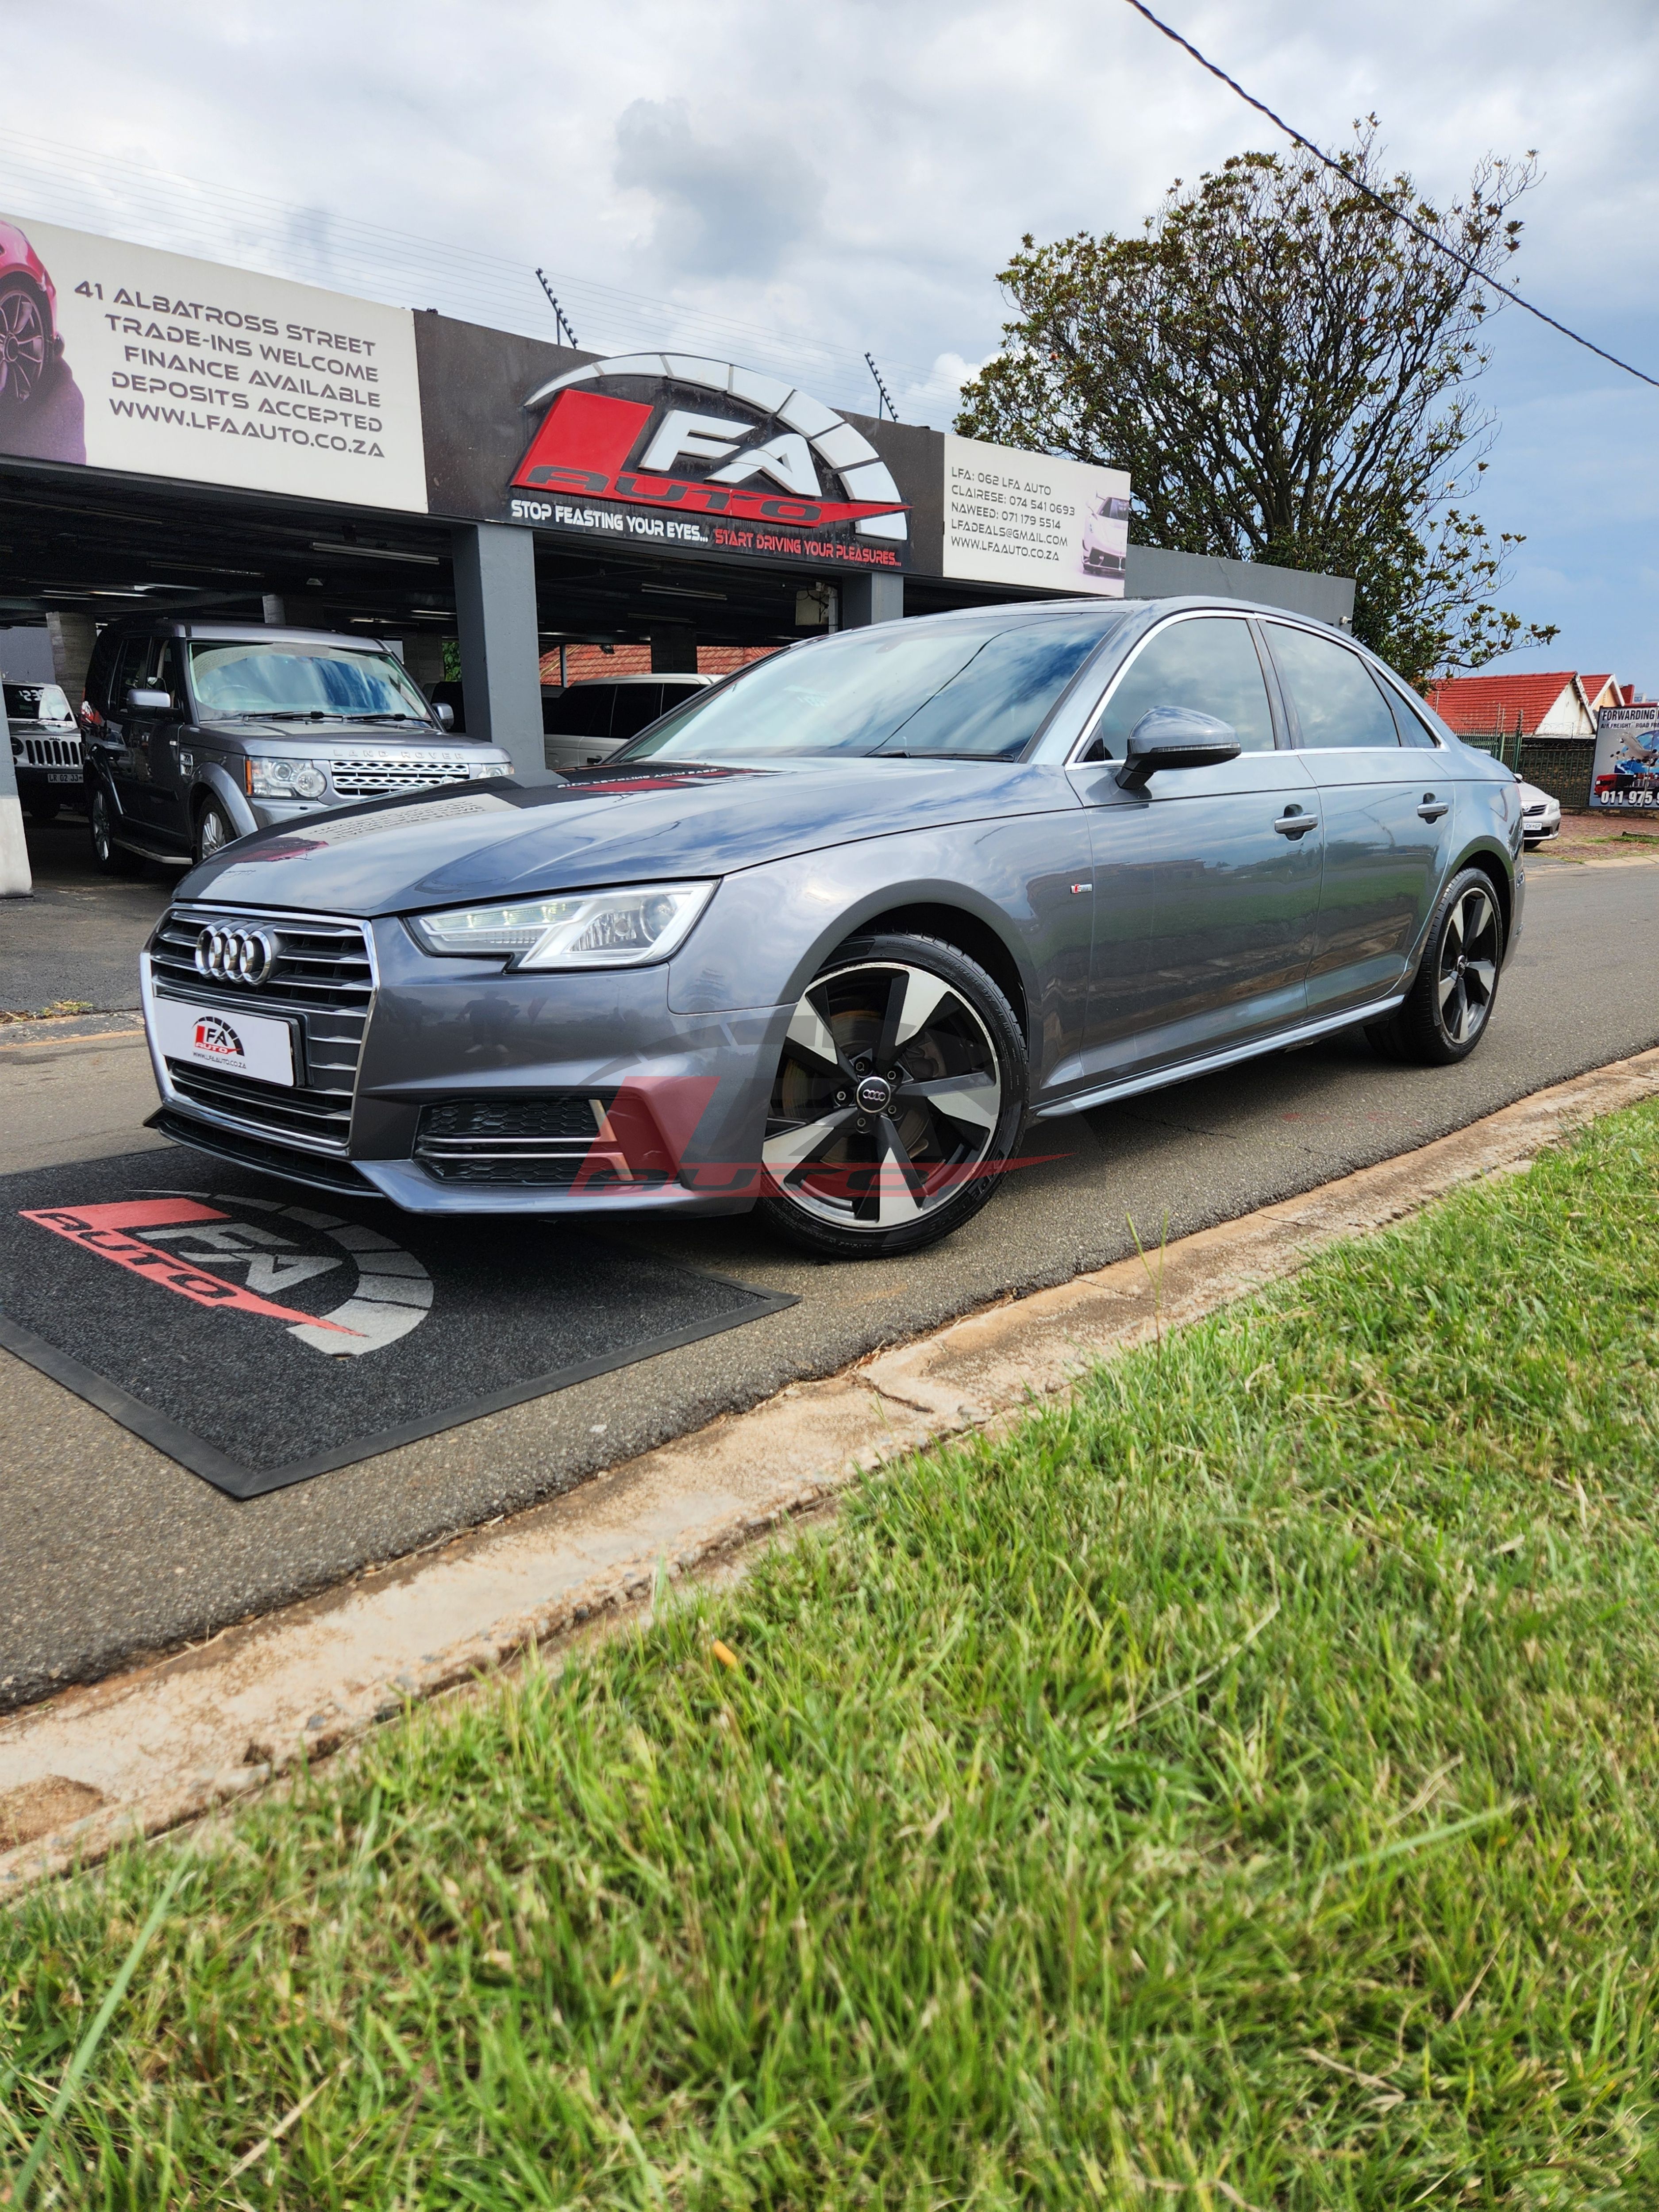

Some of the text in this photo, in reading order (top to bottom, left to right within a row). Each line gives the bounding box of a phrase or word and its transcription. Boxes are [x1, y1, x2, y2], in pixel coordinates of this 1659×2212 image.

[74, 281, 376, 356] 41 ALBATROSS STREET
[104, 313, 379, 383] TRADE-INS WELCOME
[124, 345, 381, 408] FINANCE AVAILABLE
[112, 371, 382, 432] DEPOSITS ACCEPTED
[109, 398, 385, 458] WWW.LFAAUTO.CO.ZA
[527, 465, 822, 521] AUTO
[952, 466, 1051, 496] LFA: 062 LFA AUTO
[951, 485, 1075, 516] CLAIRESE: 074 541 0693
[951, 501, 1061, 529] NAWEED: 071 179 5514
[511, 500, 902, 567] STOP FEASTING YOUR EYES... START DRIVING YOUR PLEASURES...
[951, 519, 1067, 546] LFADEALS@GMAIL.COM
[951, 536, 1059, 561] WWW.LFAAUTO.CO.ZA
[1602, 709, 1655, 720] FORWARDING
[400, 751, 465, 760] ROVER
[1601, 790, 1624, 804] 011
[1628, 791, 1653, 804] 975
[195, 1043, 228, 1054] AUTO
[36, 1212, 239, 1298] AUTO
